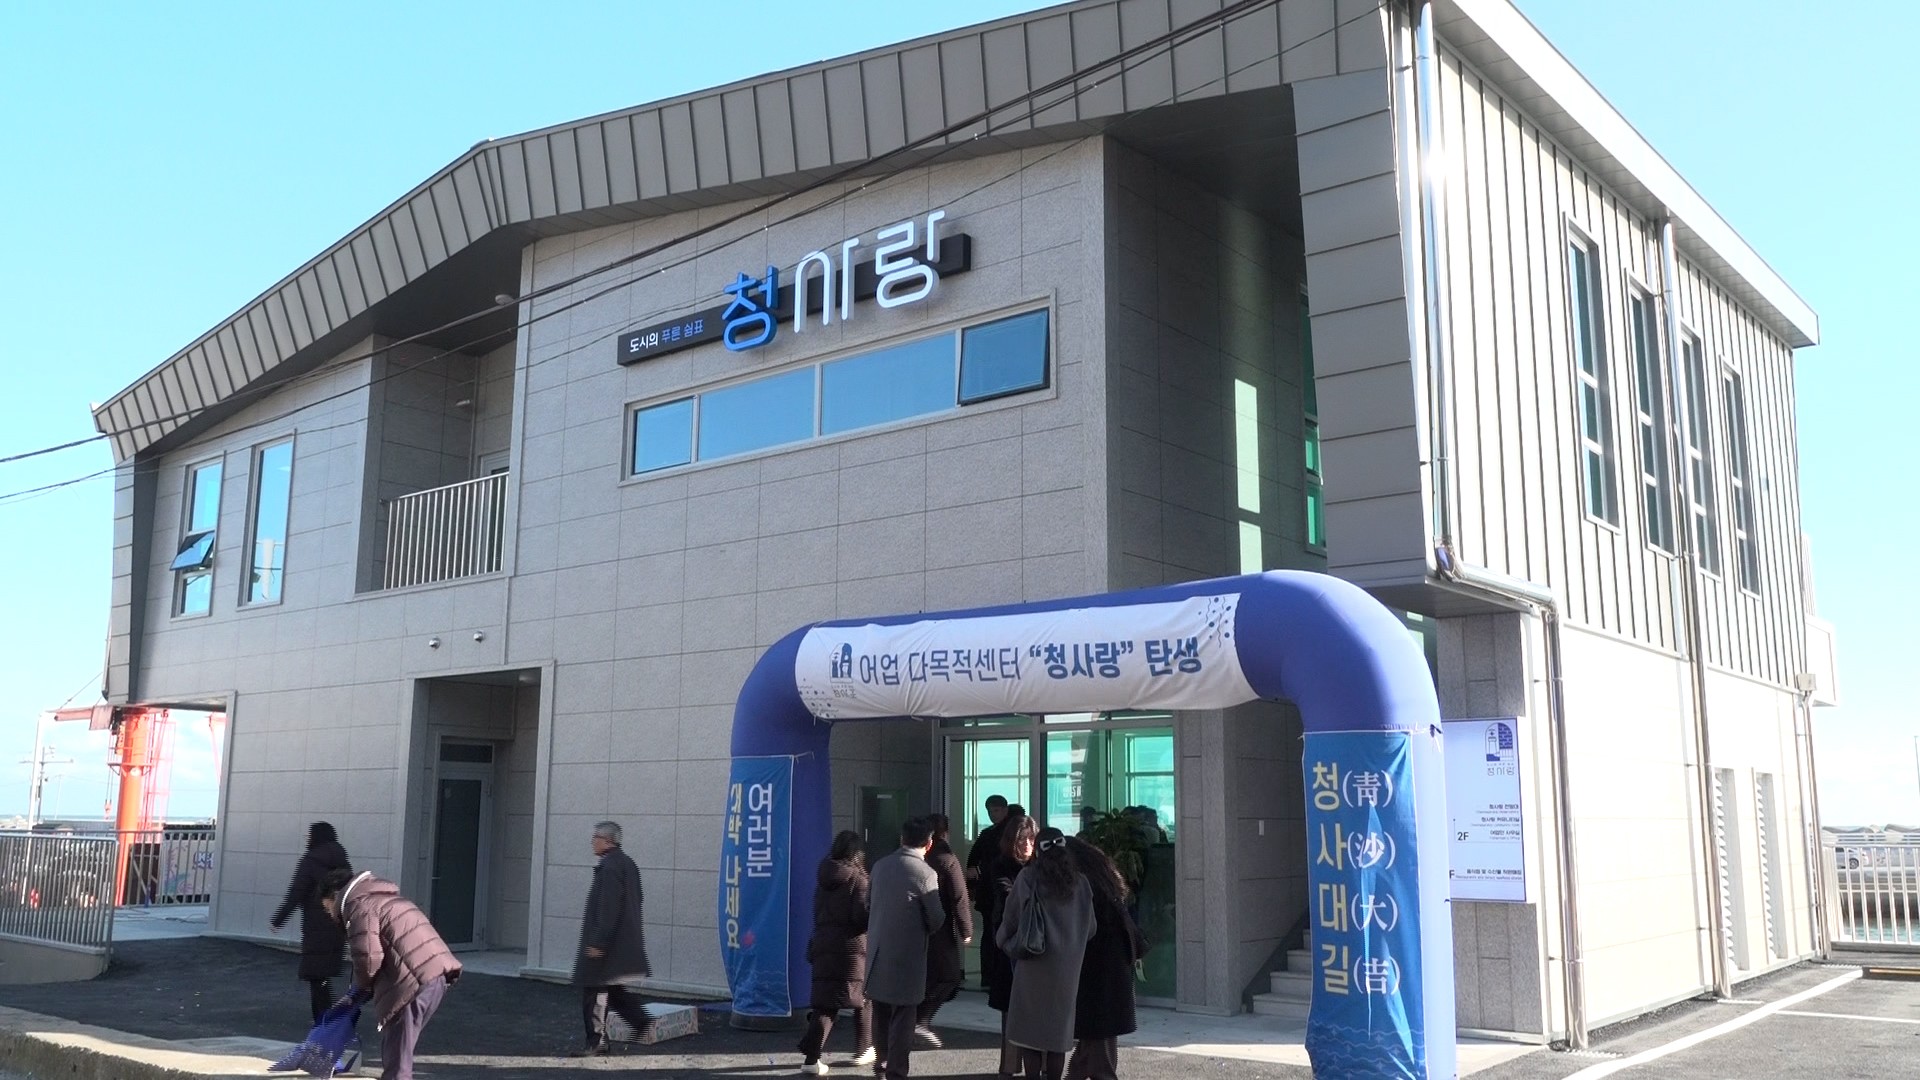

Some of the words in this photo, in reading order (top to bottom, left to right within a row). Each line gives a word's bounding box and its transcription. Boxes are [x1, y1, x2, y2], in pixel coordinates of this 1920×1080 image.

[722, 210, 946, 352] 청사랑
[630, 332, 659, 353] 도시의
[661, 326, 681, 344] 푸른
[683, 319, 704, 338] 쉼표
[859, 653, 900, 686] 어업
[908, 646, 1022, 683] 다목적센터
[1144, 636, 1203, 677] 탄생
[747, 783, 774, 878] 여러분
[1457, 831, 1469, 841] 2F
[725, 855, 741, 949] 나세요
